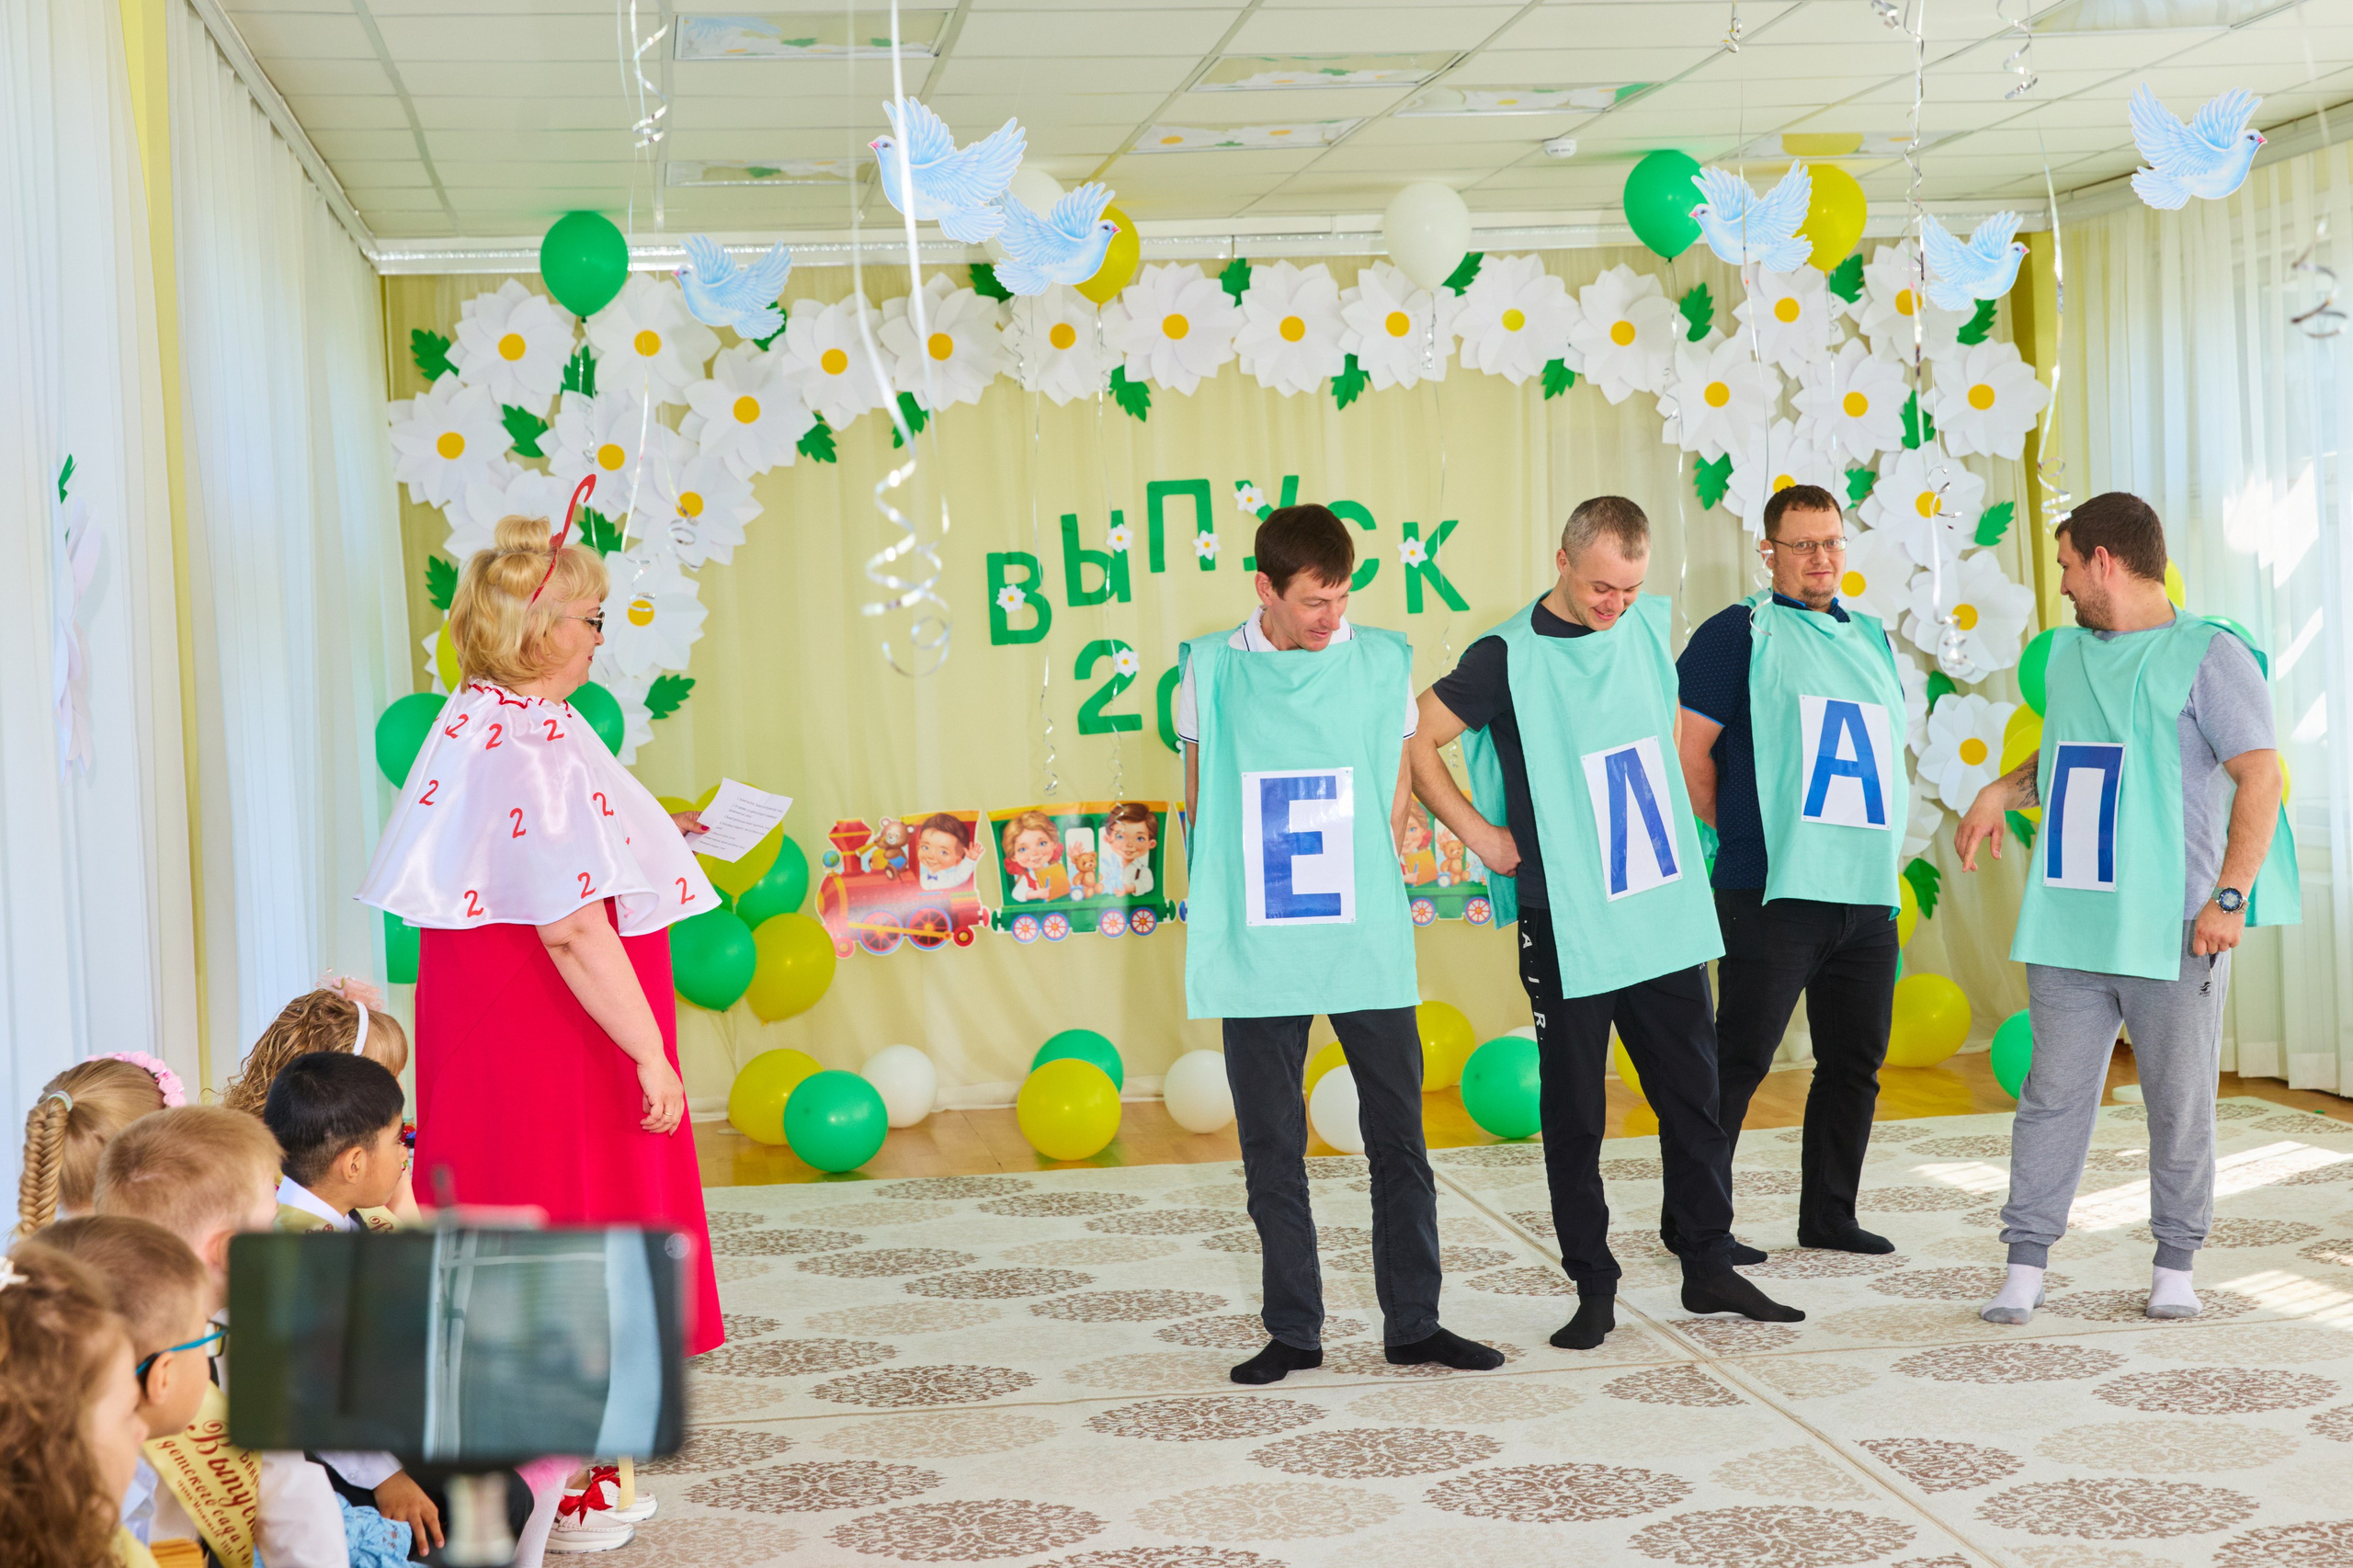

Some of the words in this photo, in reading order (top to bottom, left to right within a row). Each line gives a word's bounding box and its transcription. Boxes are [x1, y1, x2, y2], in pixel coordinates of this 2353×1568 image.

[444, 713, 470, 739] 2
[485, 722, 503, 750] 2
[543, 719, 565, 742] 2
[1804, 699, 1886, 825] А
[419, 779, 439, 806] 2
[593, 791, 615, 817] 2
[509, 807, 527, 839] 2
[1605, 746, 1677, 894] Л
[2047, 744, 2123, 883] П
[1260, 776, 1342, 919] Е
[577, 872, 597, 899] 2
[675, 877, 696, 905] 2
[463, 890, 484, 918] 2
